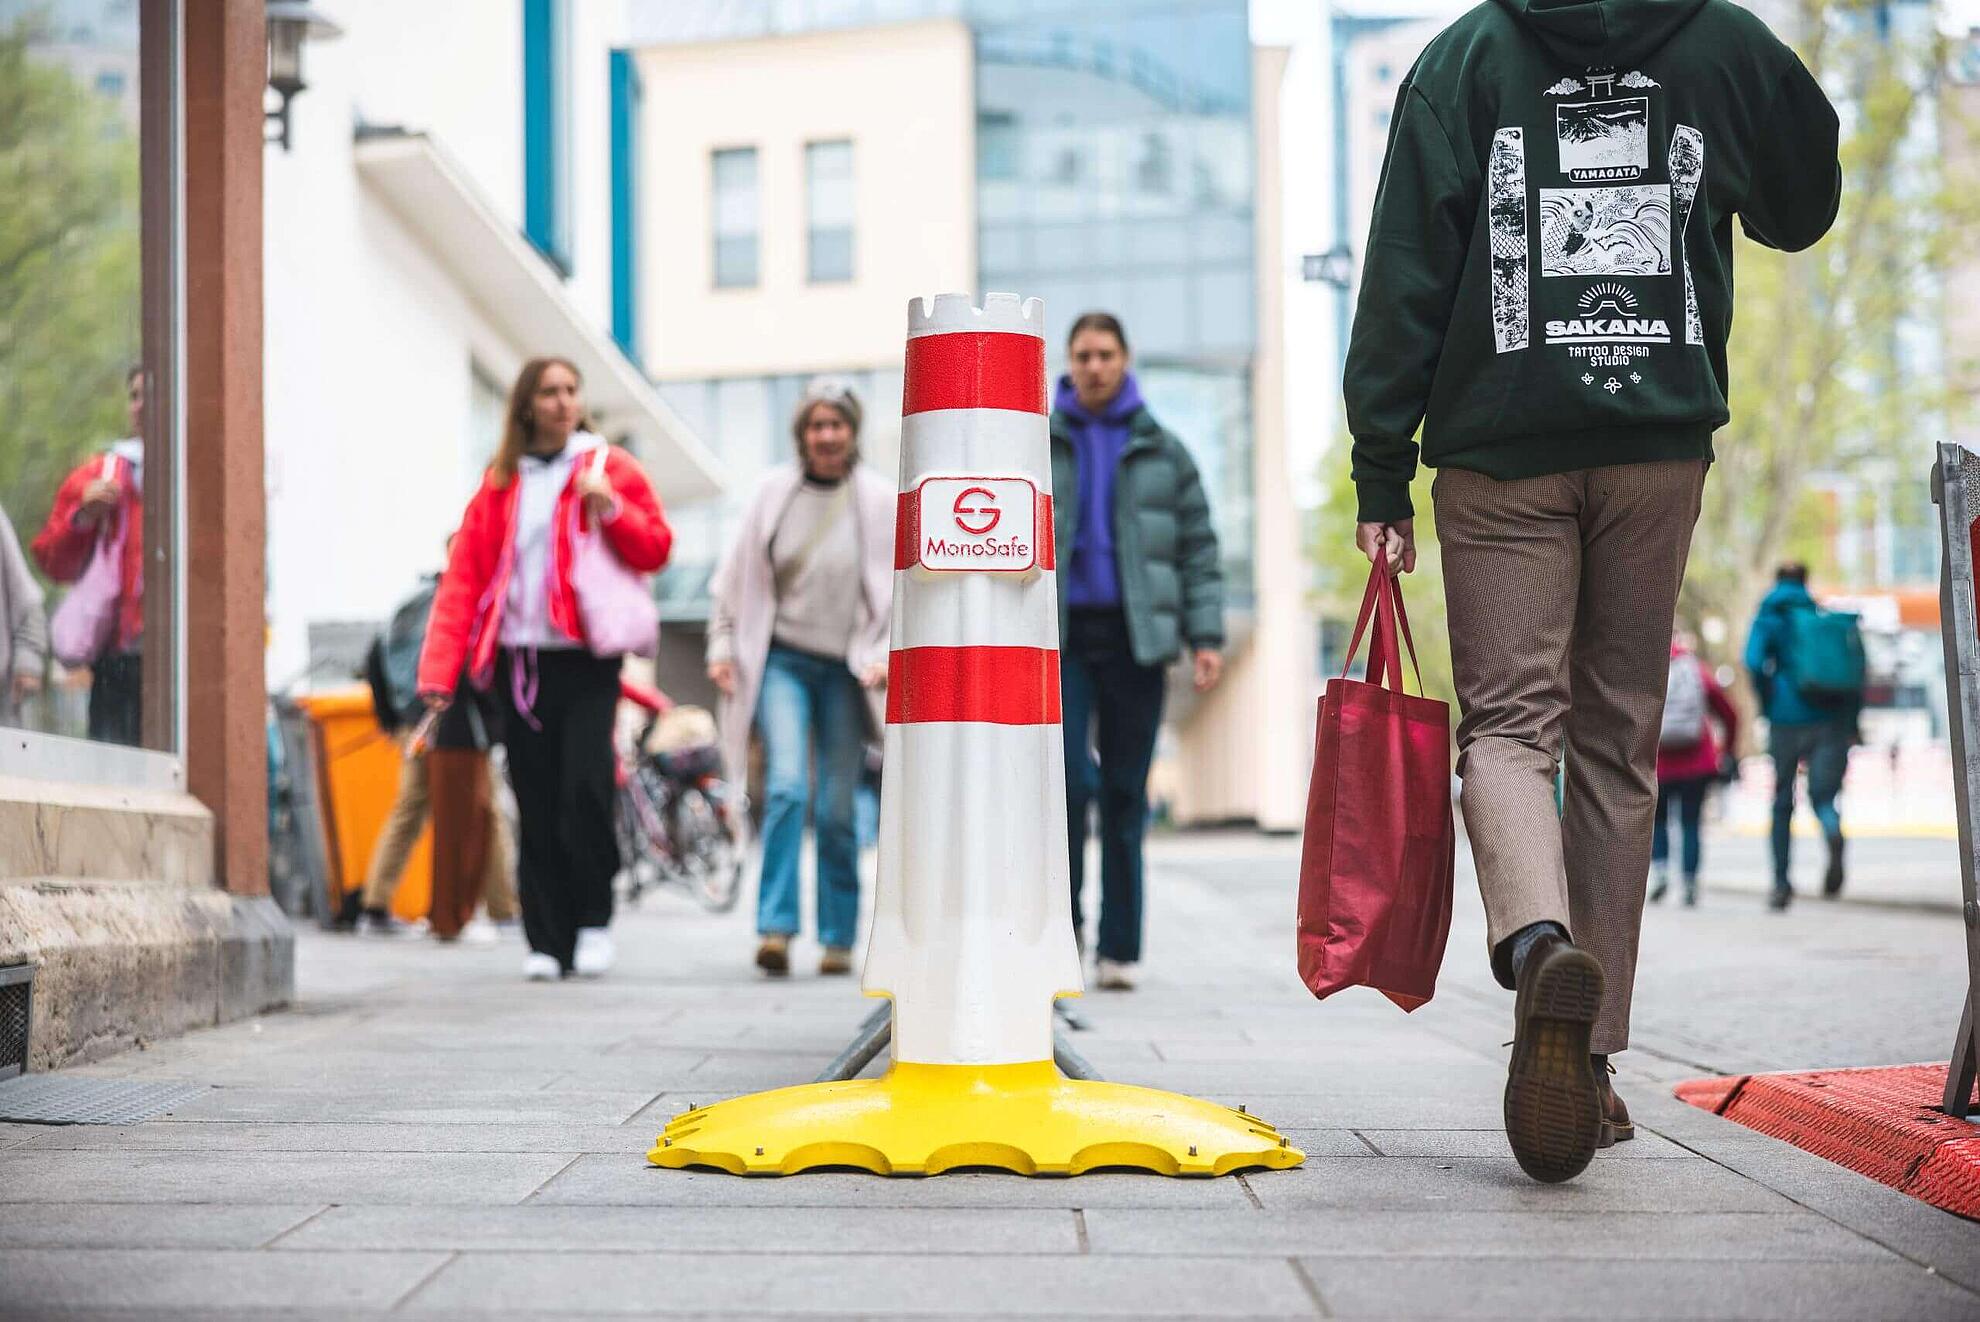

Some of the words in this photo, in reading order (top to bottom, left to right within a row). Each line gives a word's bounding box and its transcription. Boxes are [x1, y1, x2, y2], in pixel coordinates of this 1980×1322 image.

[1545, 319, 1671, 336] SAKANA
[1568, 346, 1609, 357] TATTOO
[1613, 345, 1650, 357] DESIGN
[1590, 355, 1630, 367] STUDIO
[926, 536, 1029, 556] MonoSafe
